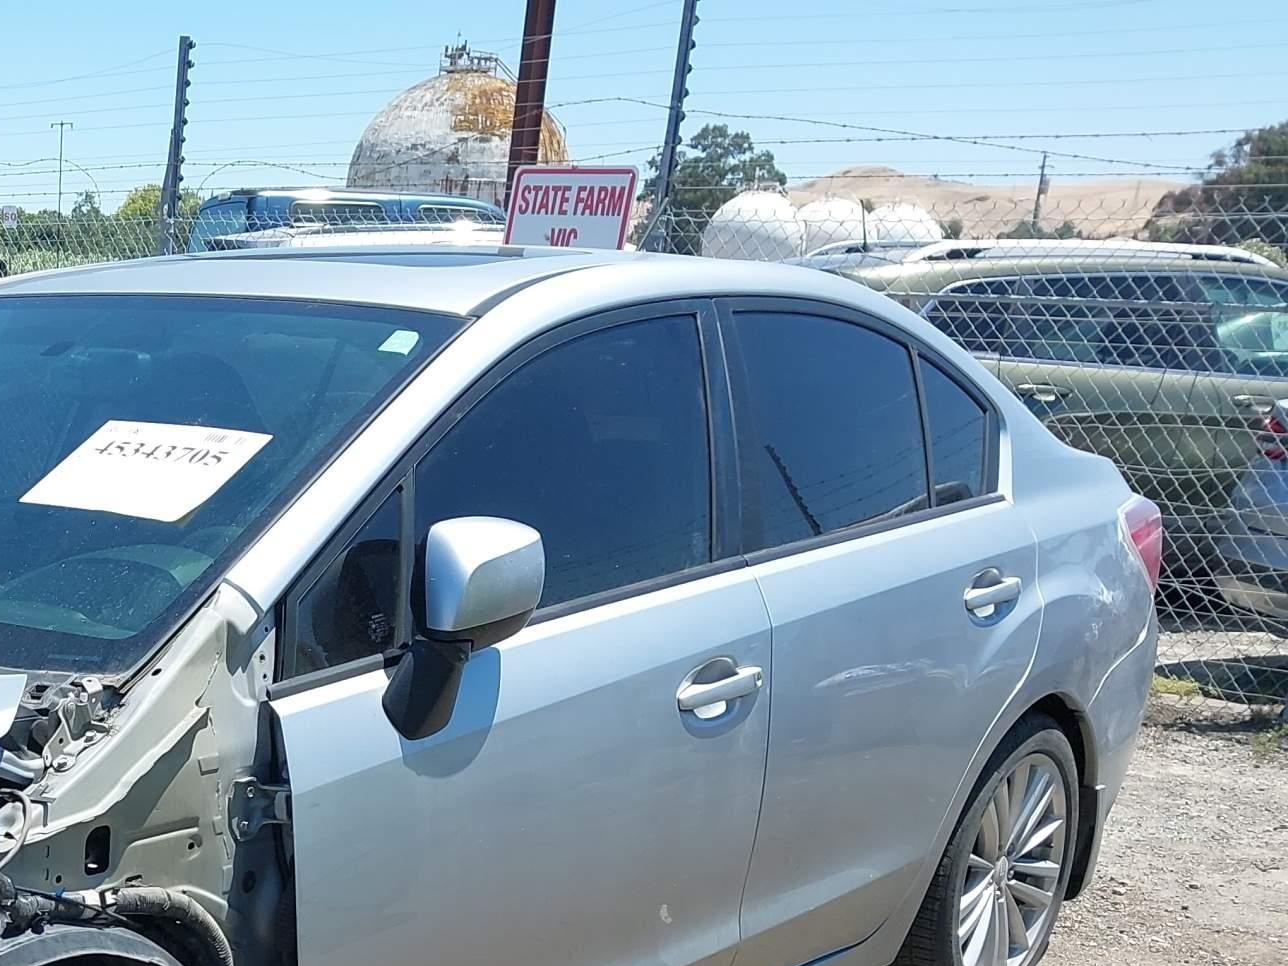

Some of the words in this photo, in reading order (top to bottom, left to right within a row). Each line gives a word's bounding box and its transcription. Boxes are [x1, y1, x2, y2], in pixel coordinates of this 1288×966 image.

[518, 185, 572, 216] STATE
[573, 186, 626, 217] FARM
[550, 228, 578, 247] VIC
[95, 440, 229, 466] 45343705
